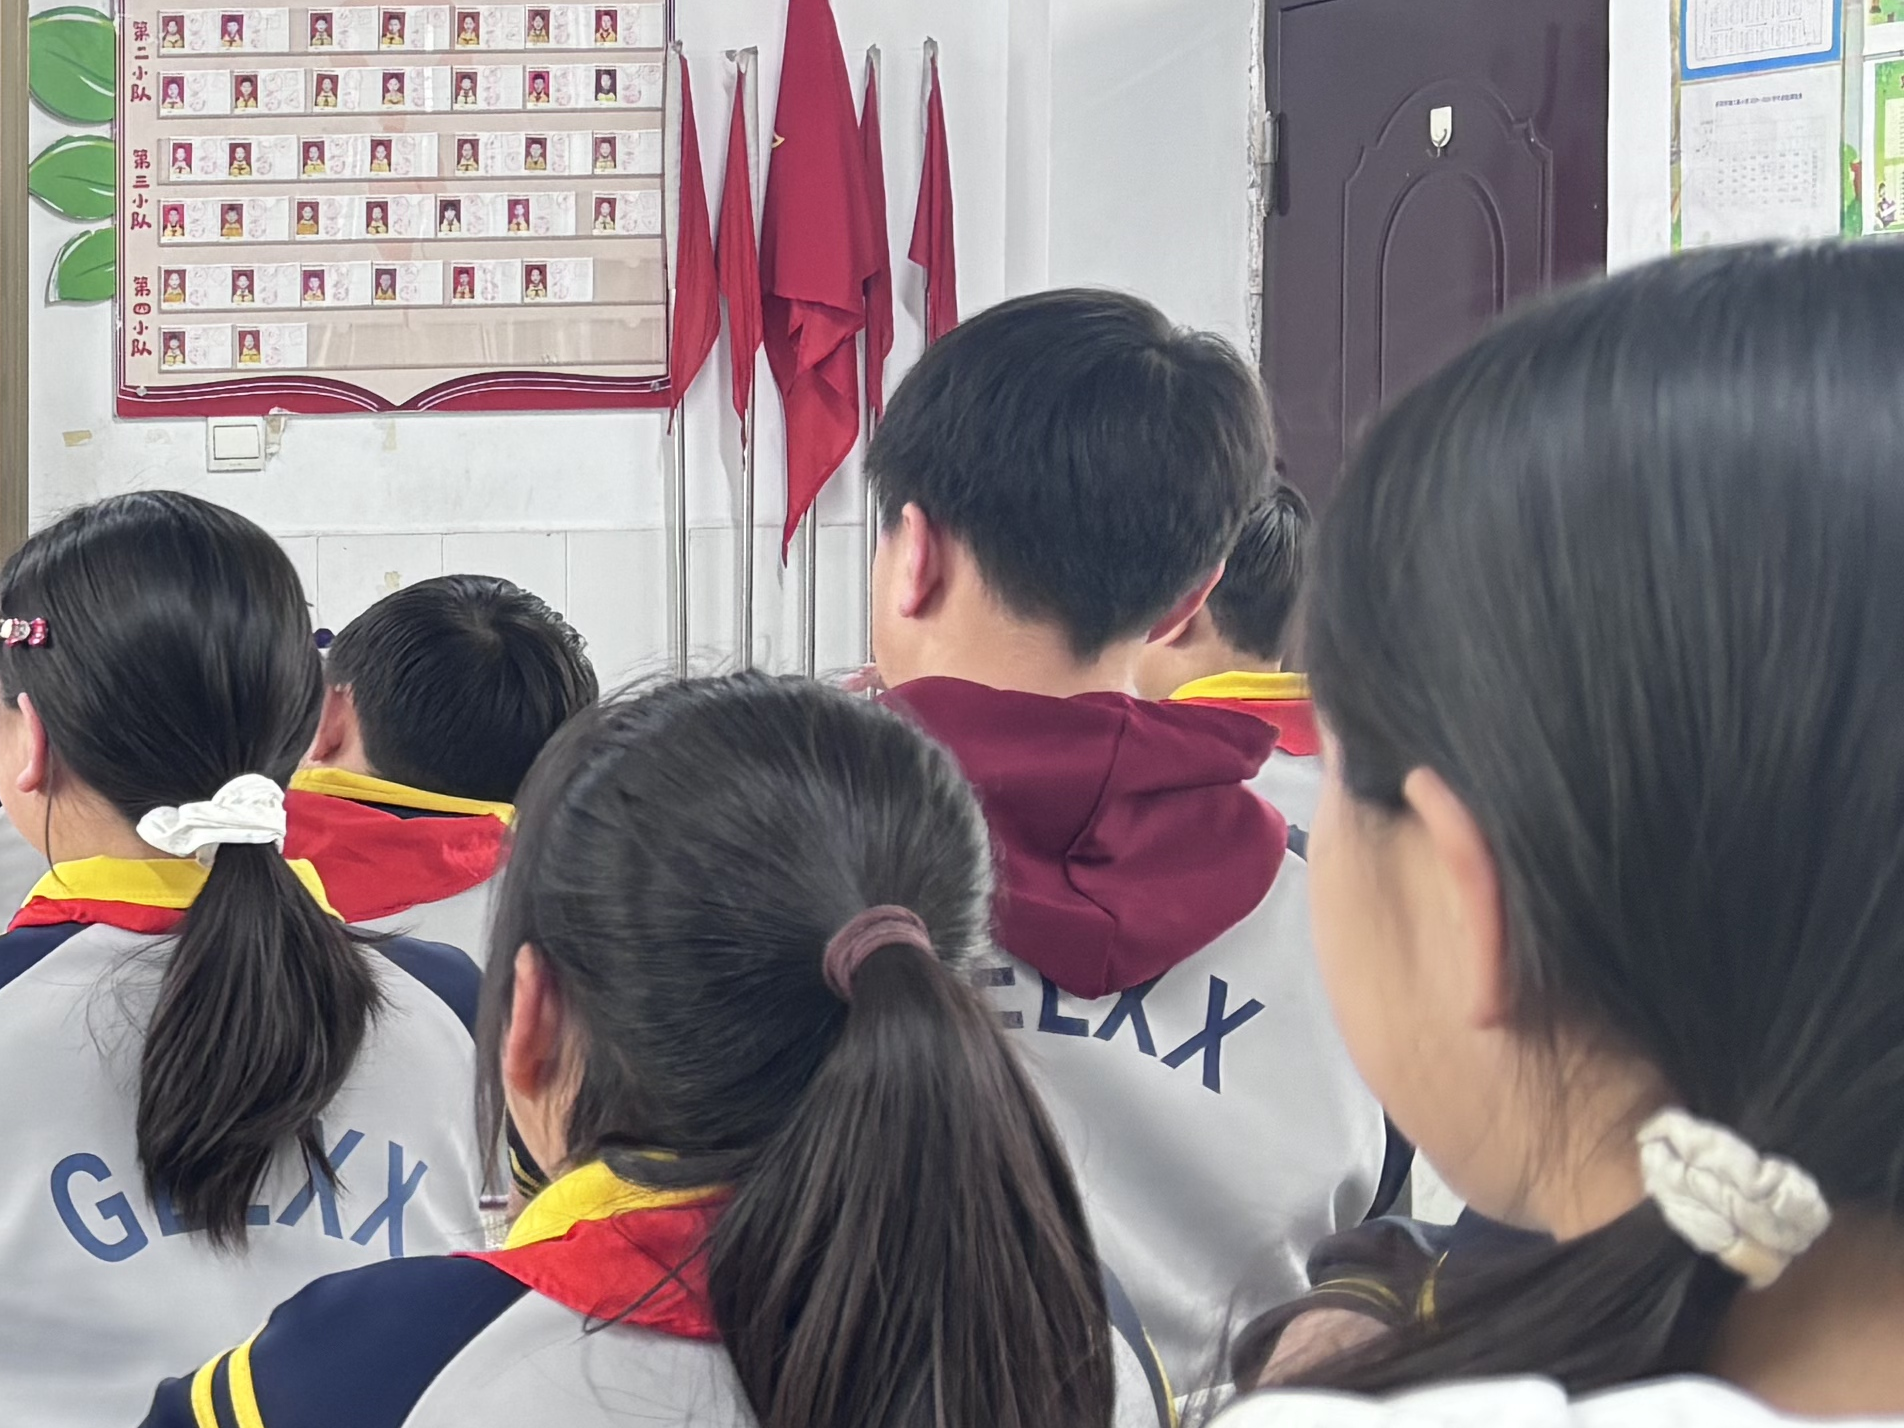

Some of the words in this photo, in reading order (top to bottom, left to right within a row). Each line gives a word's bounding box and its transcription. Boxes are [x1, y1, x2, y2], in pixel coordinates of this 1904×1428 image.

[129, 20, 153, 105] 第二小队
[129, 148, 153, 232] 第三小队
[129, 275, 153, 359] 第四小队
